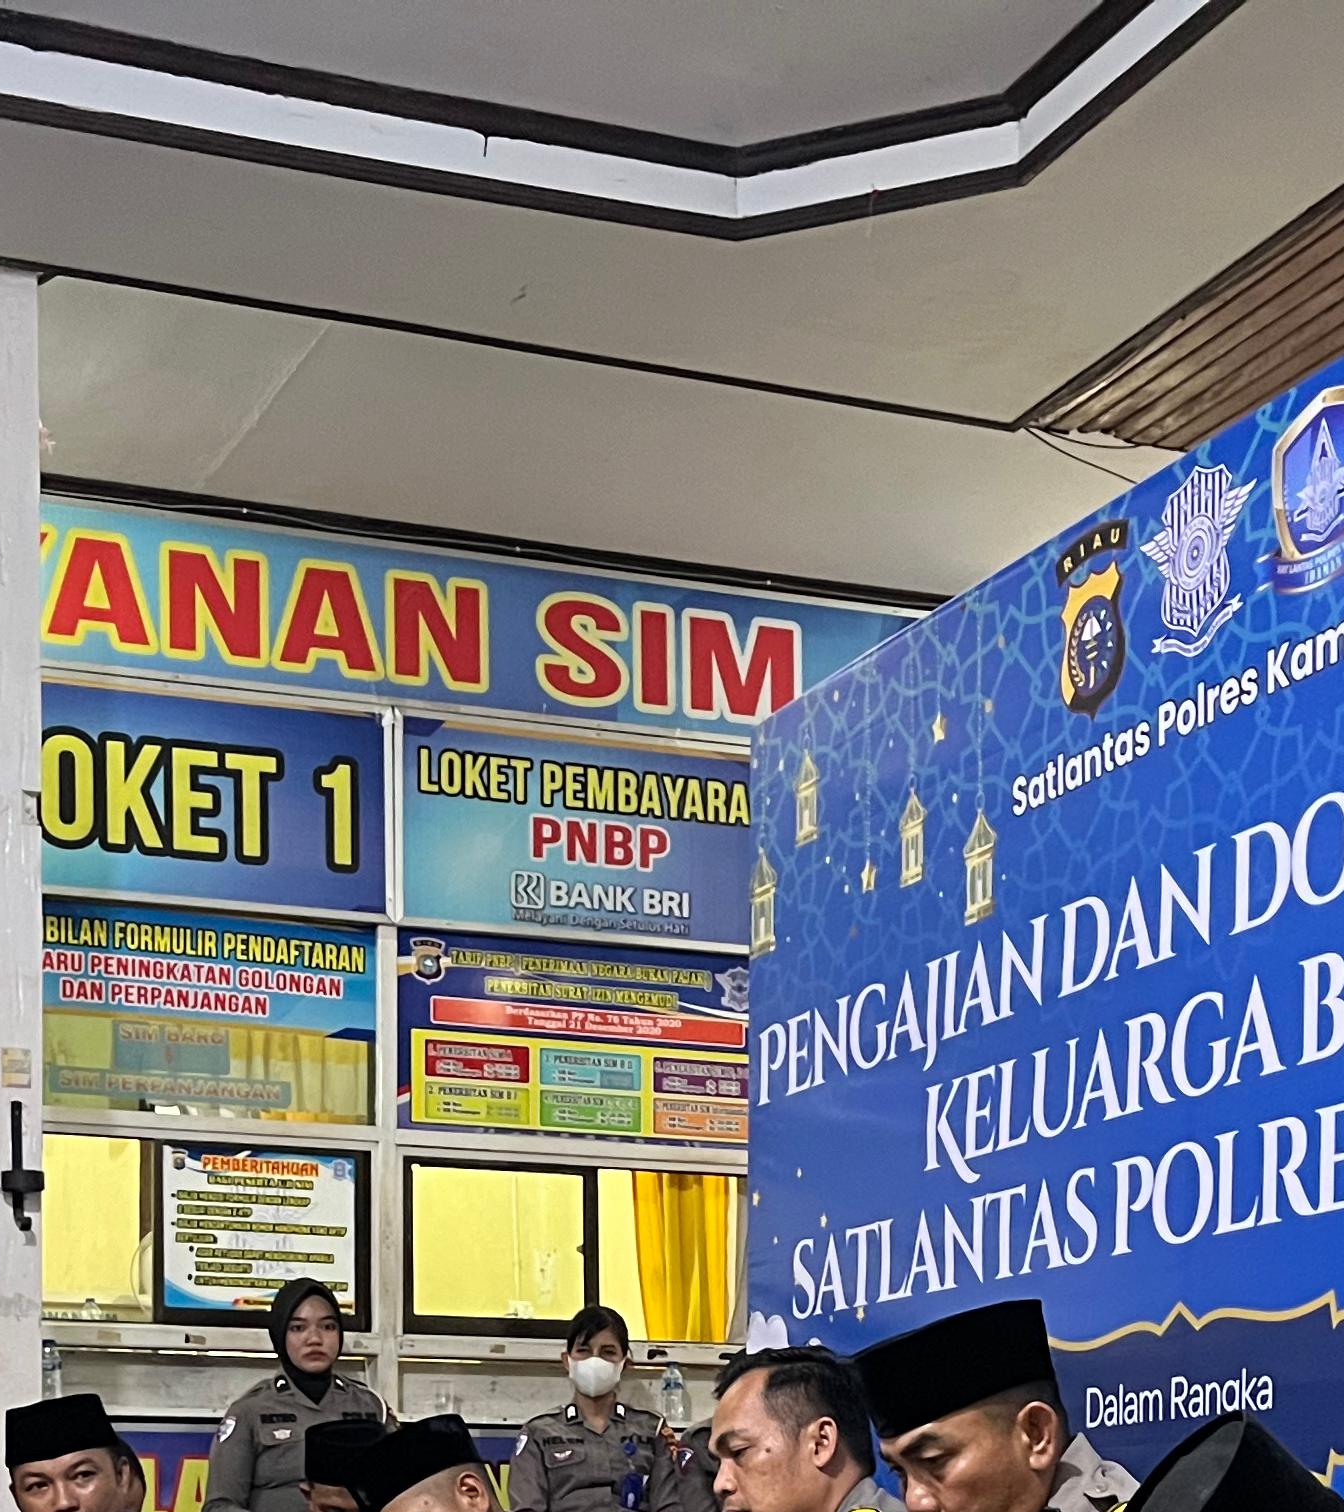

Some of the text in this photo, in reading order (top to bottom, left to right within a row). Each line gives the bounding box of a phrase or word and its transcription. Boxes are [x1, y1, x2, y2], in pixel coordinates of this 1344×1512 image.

[1063, 528, 1121, 574] RIAU
[536, 588, 804, 722] SIM
[1012, 722, 1150, 816] Satlantas
[1157, 666, 1259, 747] Polres
[418, 747, 750, 826] LOKET PEMBAYARA
[311, 756, 363, 873] 1
[529, 814, 670, 871] PNBP
[513, 909, 567, 927] Melayani
[570, 914, 617, 932] Dengan
[664, 921, 689, 934] Hati
[549, 881, 689, 918] BANK BRI
[114, 921, 217, 957] FORMULIR
[223, 927, 366, 974] PENDAFTARAN
[61, 978, 268, 1017] DAN PERPANJANGAN
[91, 957, 231, 988] PENINGKATAN
[238, 967, 343, 998] GOLONGAN
[757, 912, 1046, 1106] PENGAJIAN
[1058, 842, 1211, 997] DAN
[656, 1018, 682, 1029] 2020
[59, 1069, 282, 1101] SIM PERPANJANGAN
[923, 975, 1286, 1182] KELUARGA
[203, 1155, 319, 1177] PEMBERITAHUAN
[792, 1167, 1097, 1321] SATLANTAS
[1086, 1379, 1162, 1429] Dalam
